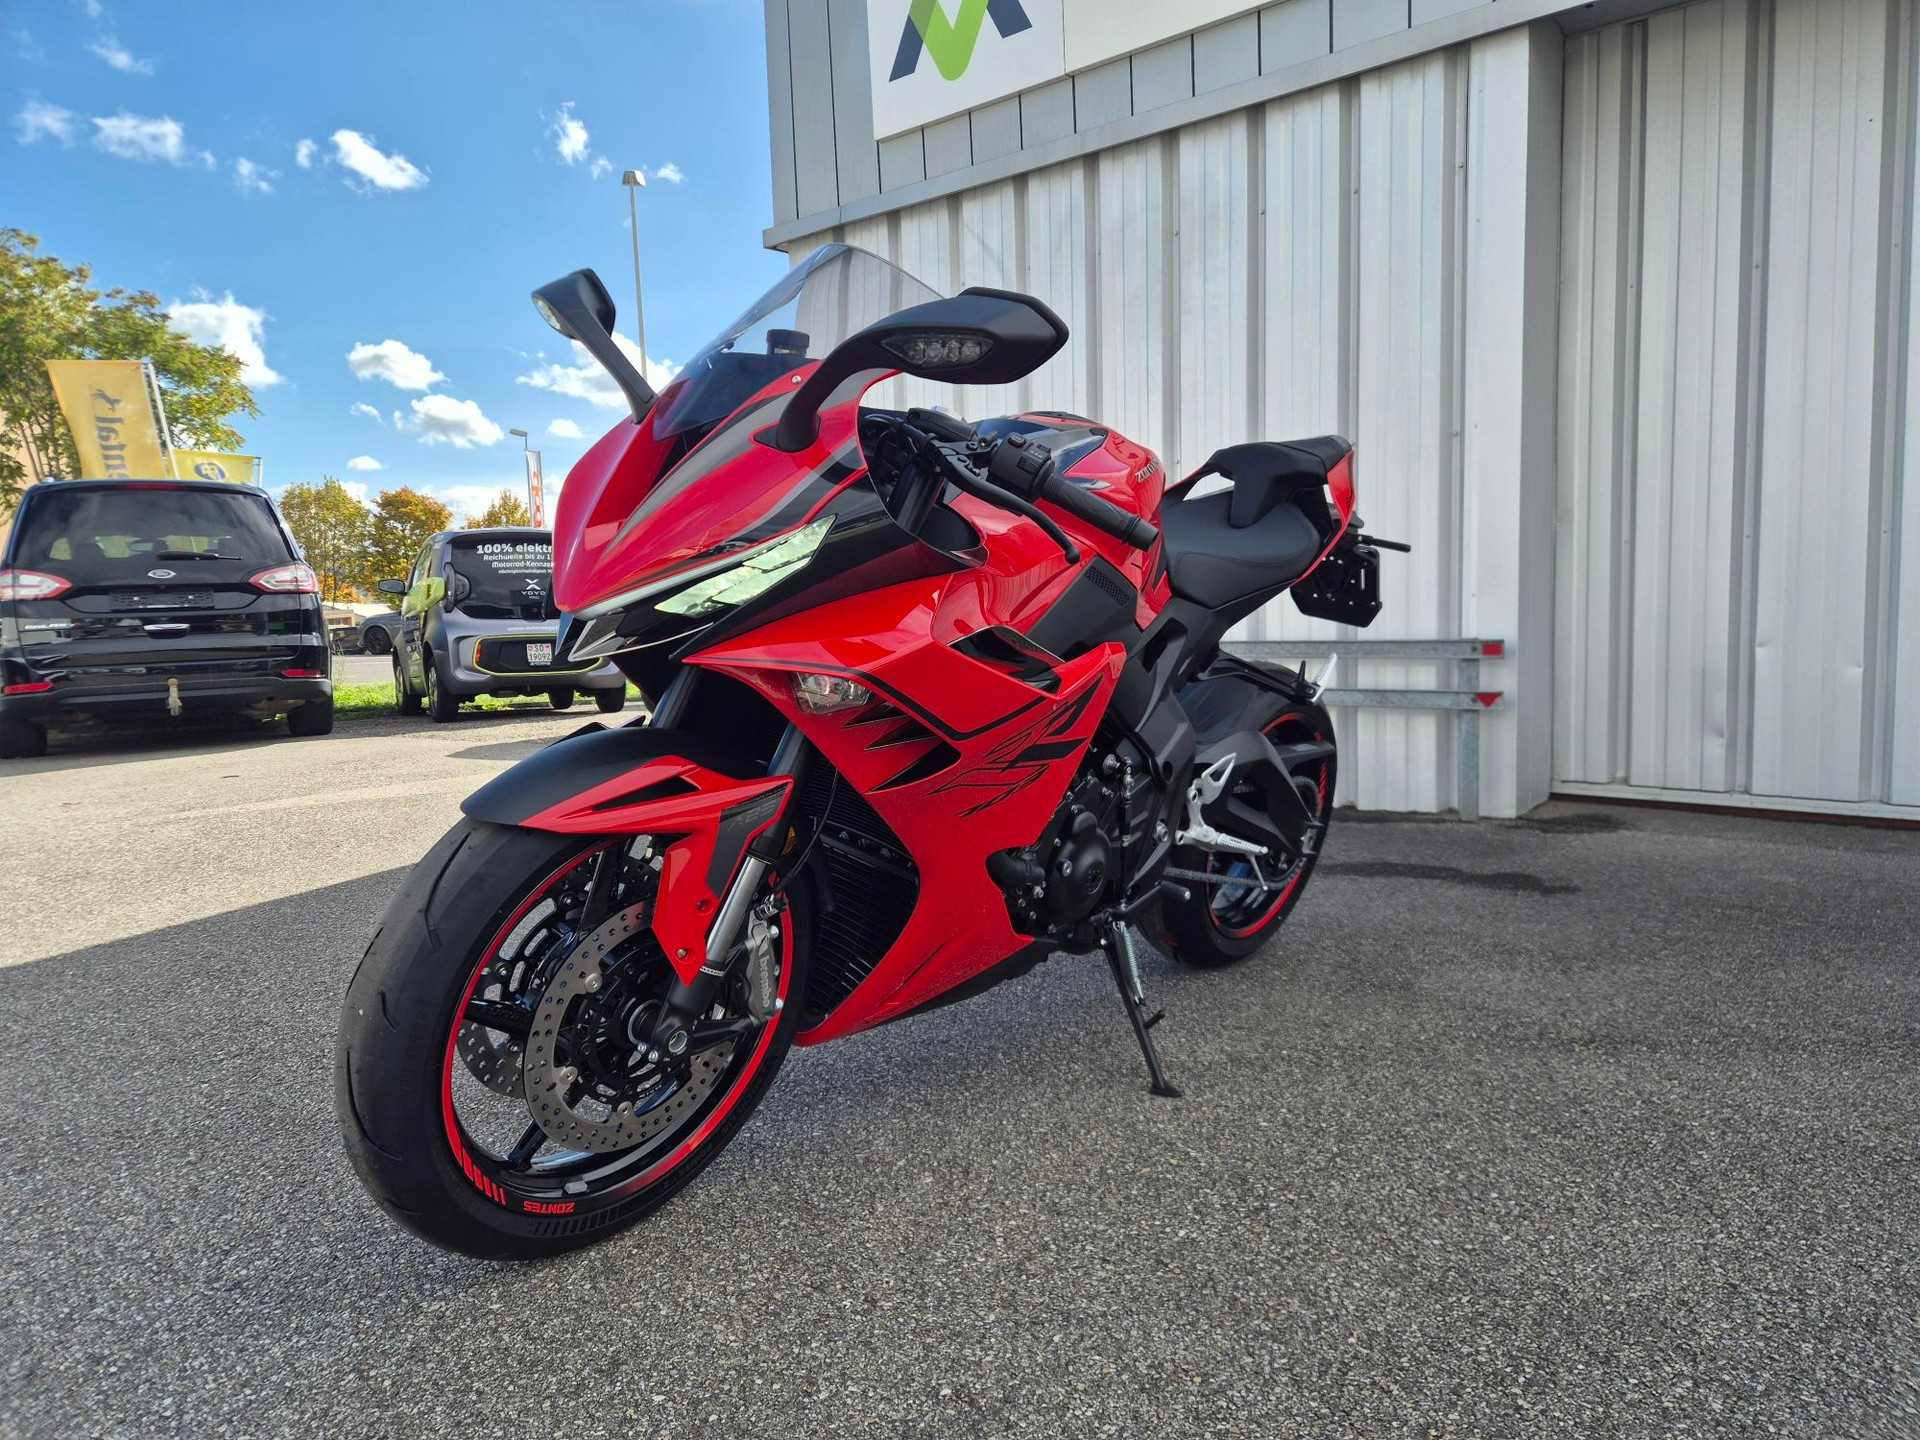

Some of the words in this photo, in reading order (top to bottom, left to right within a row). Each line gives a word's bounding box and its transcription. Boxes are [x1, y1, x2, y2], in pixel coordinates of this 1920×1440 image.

[476, 543, 513, 554] 100%
[483, 553, 523, 561] Reichweite
[534, 644, 544, 652] SO
[759, 955, 772, 1008] brembo
[523, 1200, 576, 1214] ZONTES
